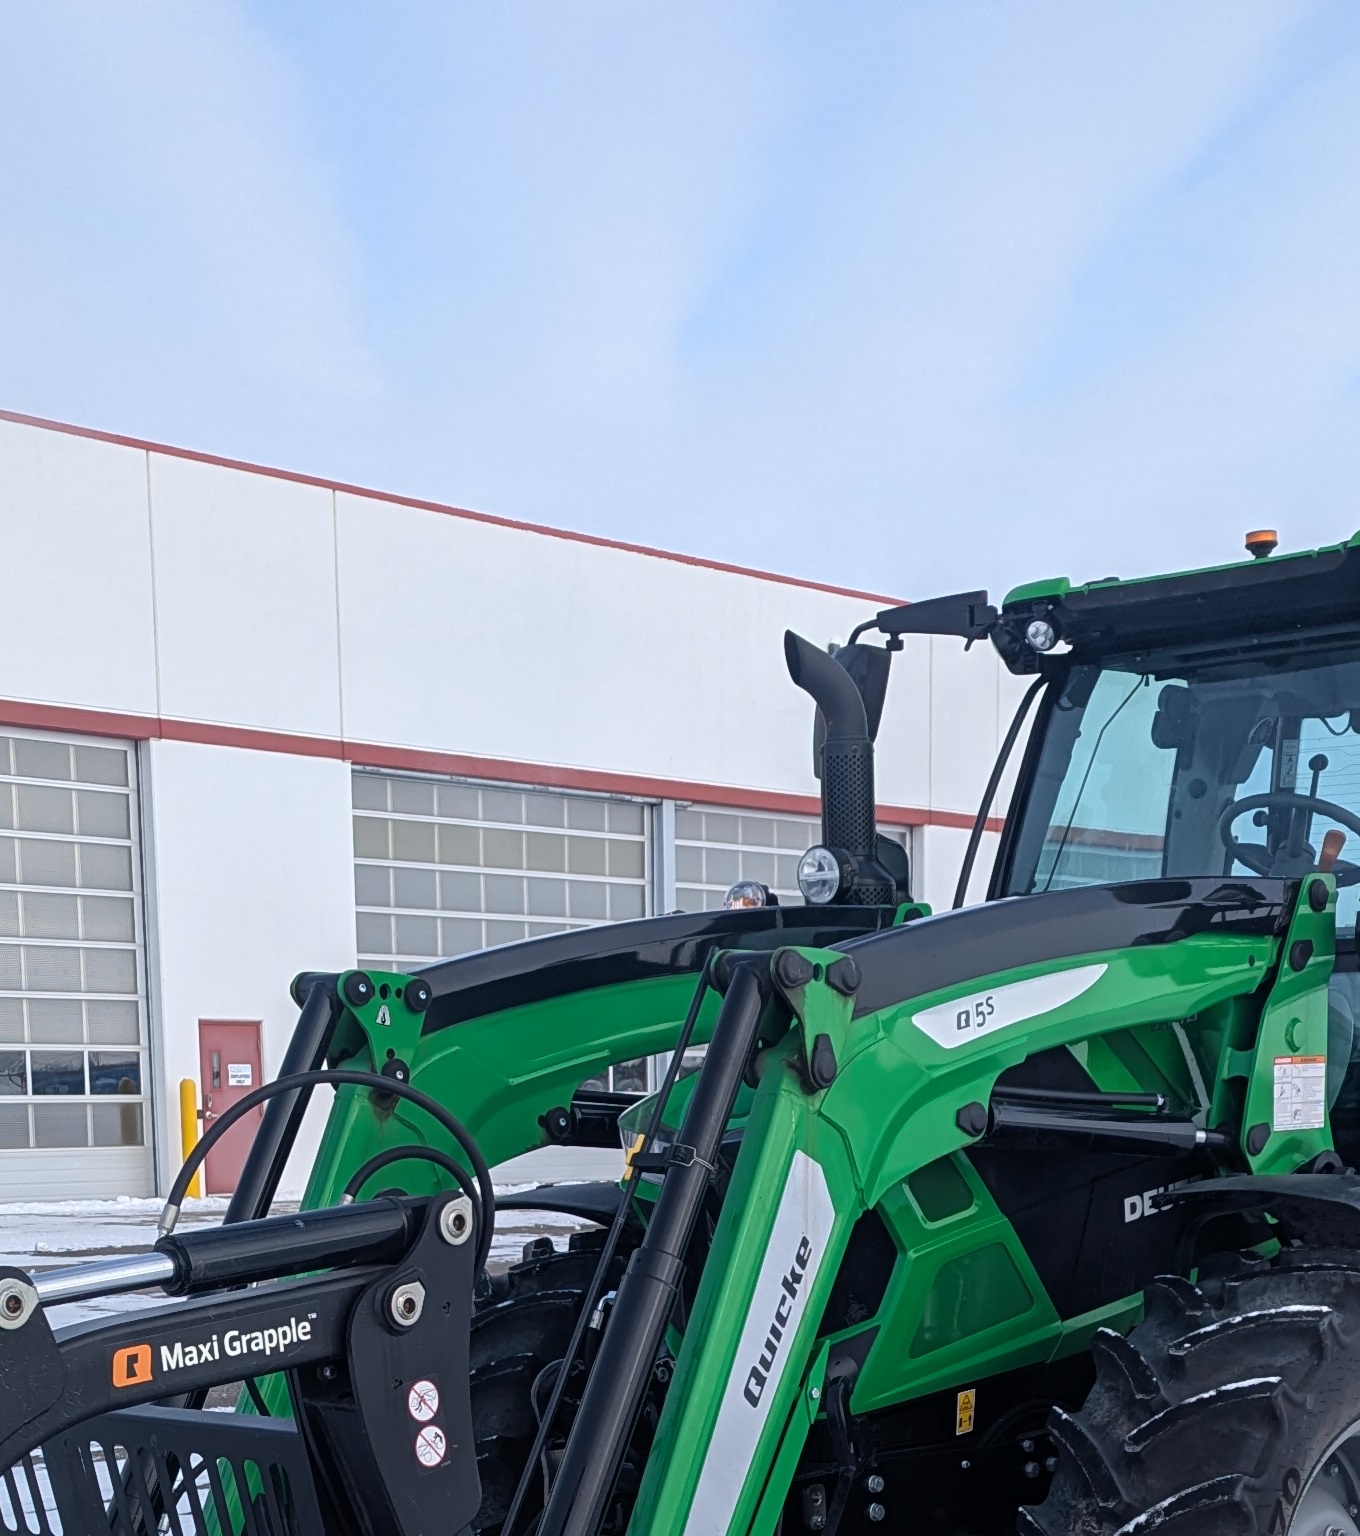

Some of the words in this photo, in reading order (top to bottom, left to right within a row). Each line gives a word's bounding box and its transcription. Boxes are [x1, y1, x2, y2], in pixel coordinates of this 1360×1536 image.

[160, 1335, 220, 1372] Maxi
[224, 1317, 312, 1357] Grapple
[743, 1235, 813, 1409] Quicke
